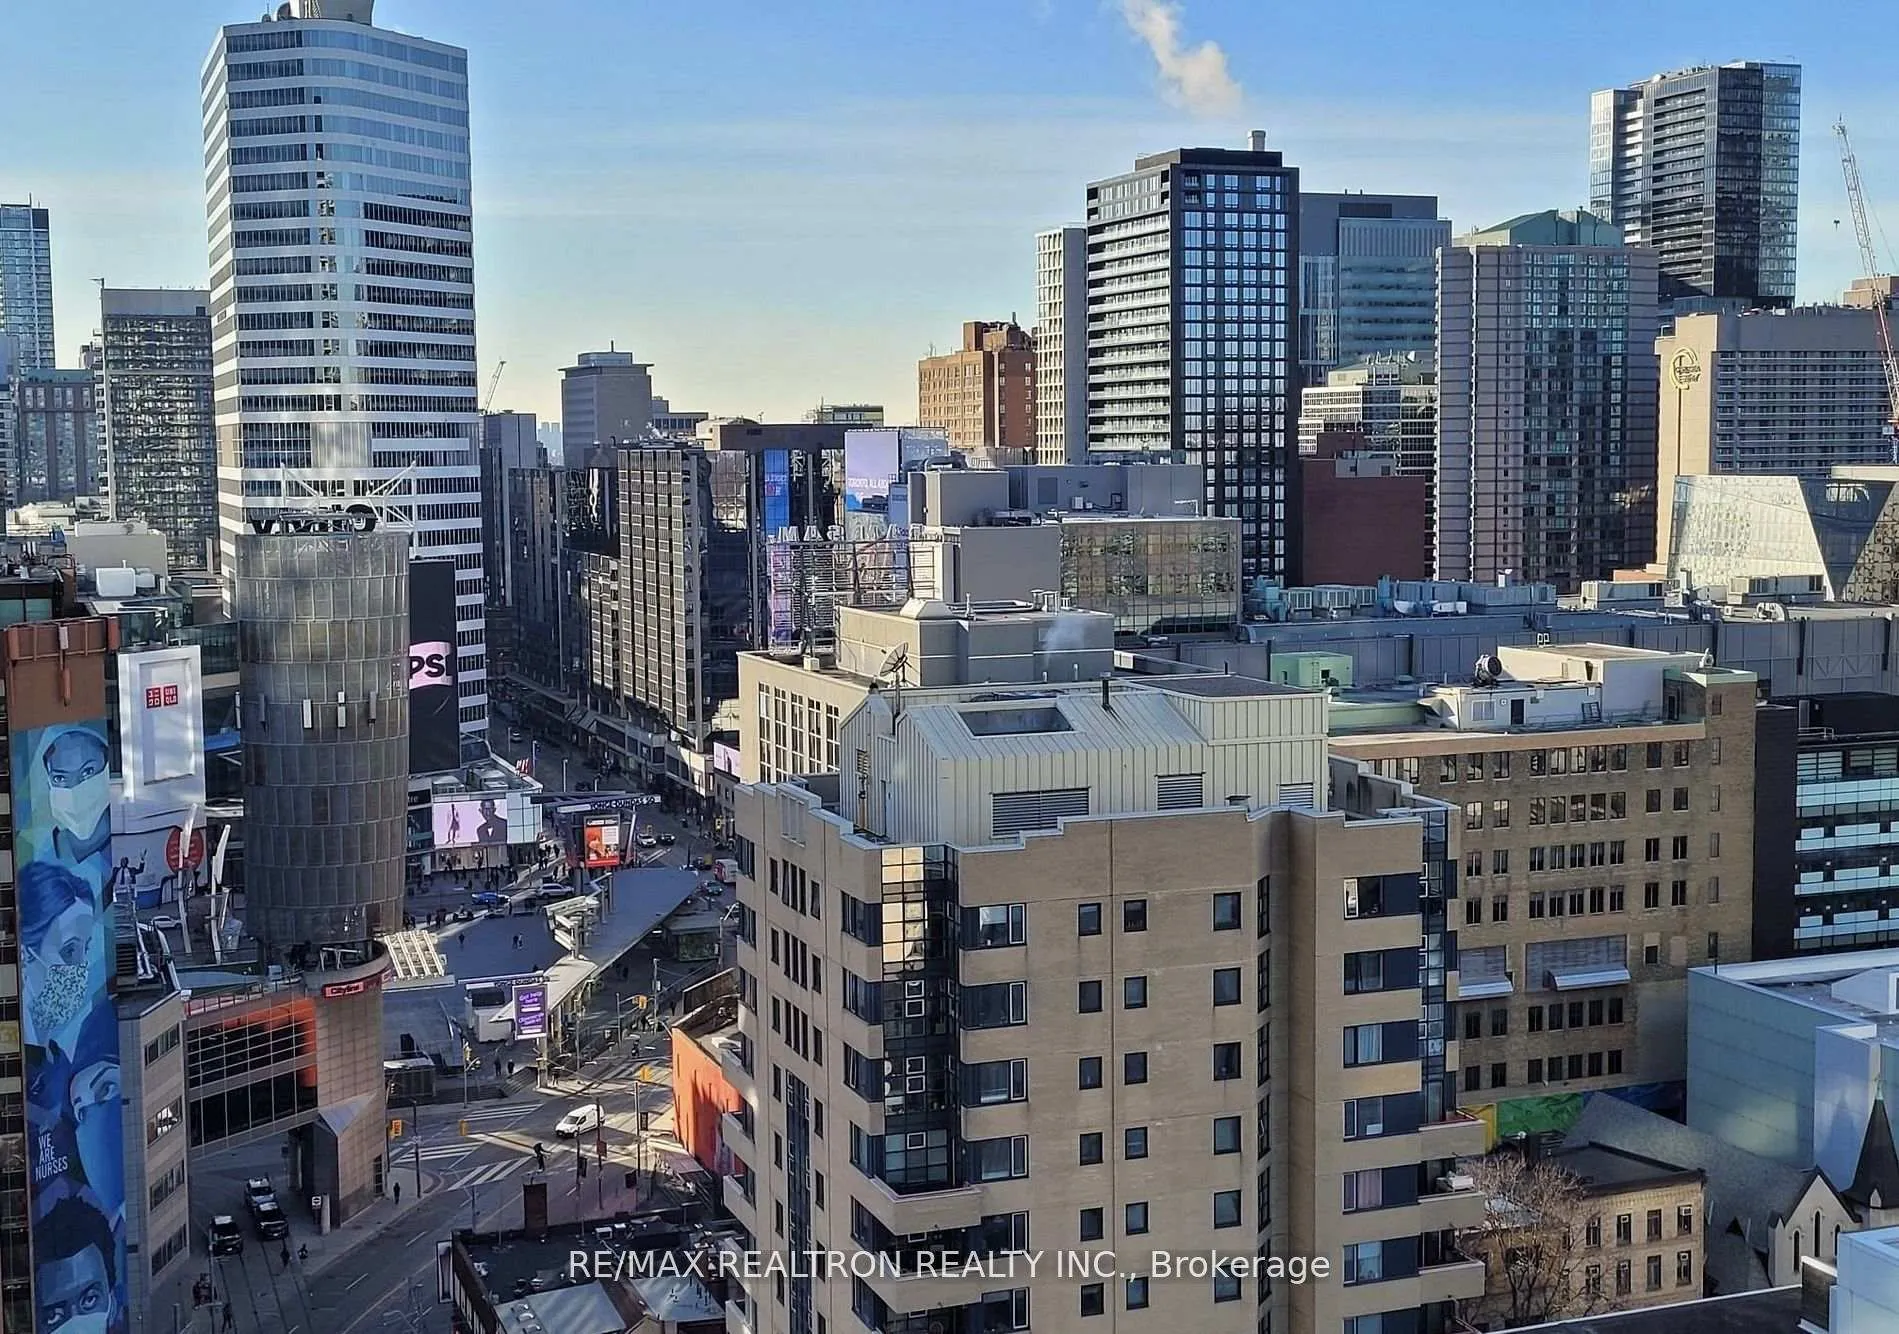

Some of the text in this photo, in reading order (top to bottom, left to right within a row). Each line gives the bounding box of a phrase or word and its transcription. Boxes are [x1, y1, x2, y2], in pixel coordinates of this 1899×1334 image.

[39, 1133, 51, 1149] WE
[40, 1146, 55, 1164] ARE
[36, 1156, 68, 1181] NURSES
